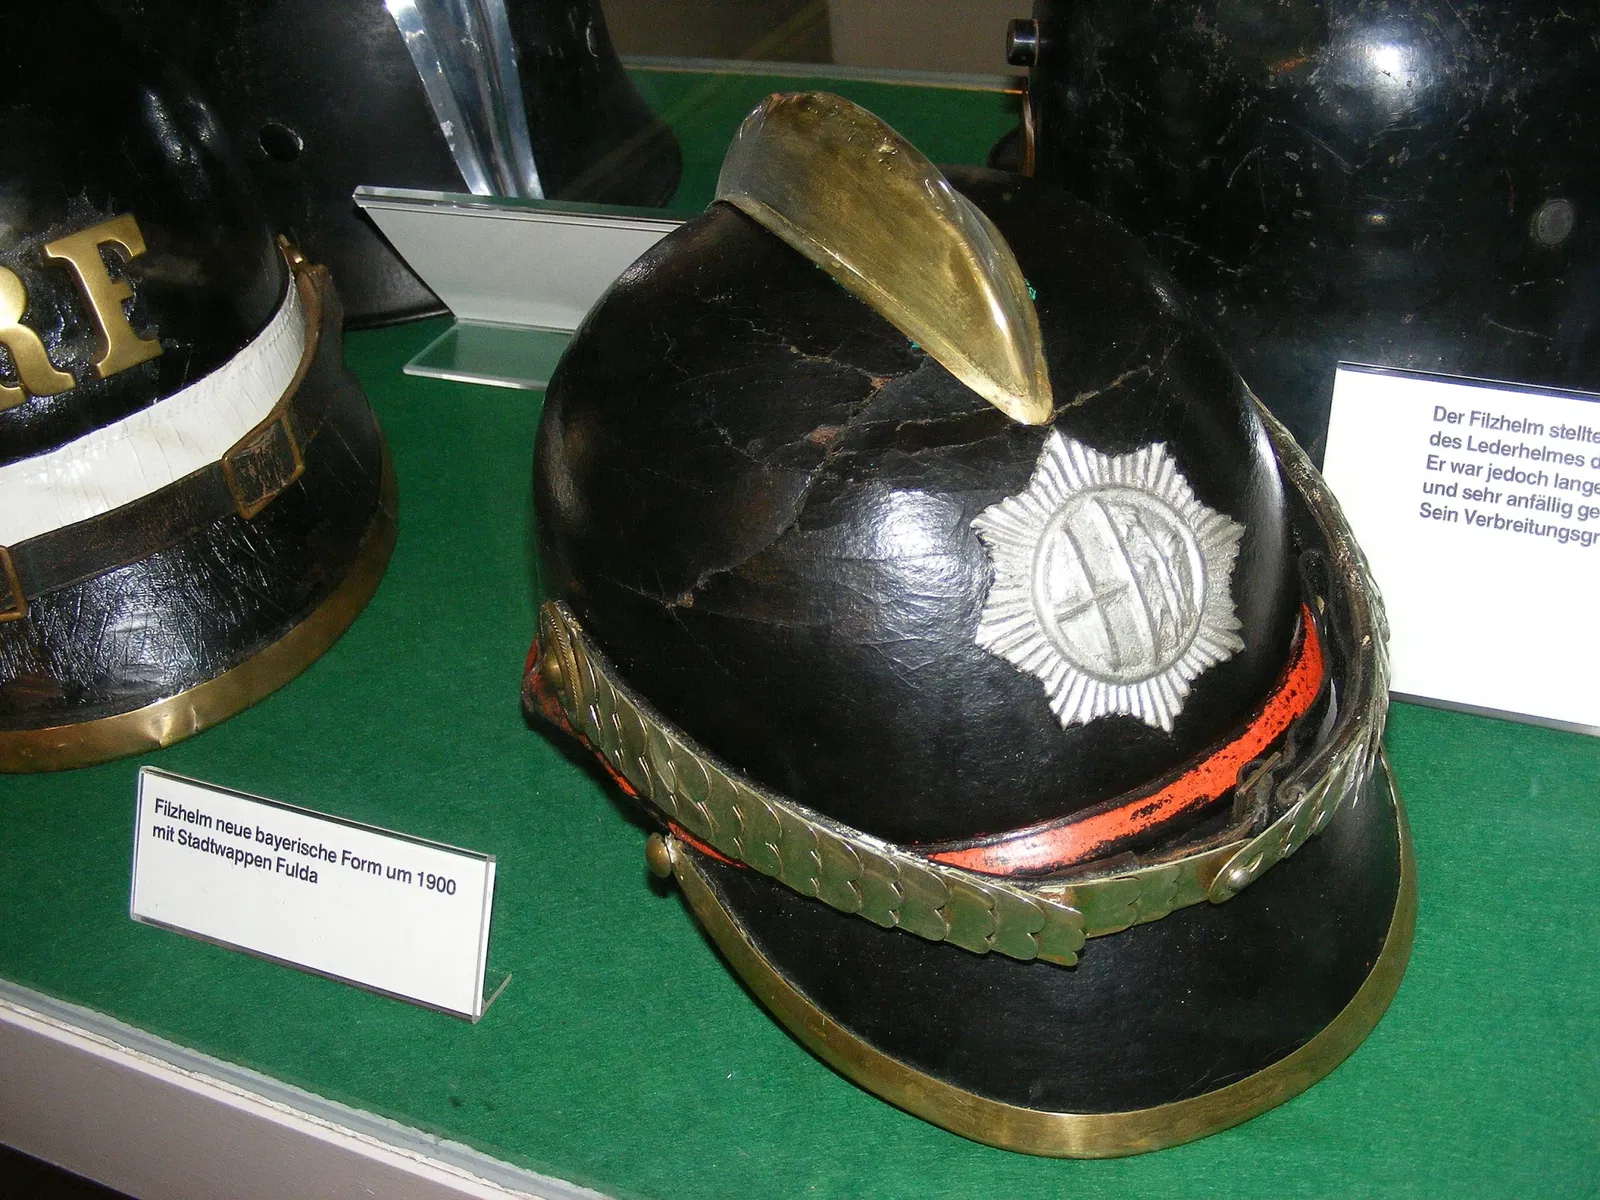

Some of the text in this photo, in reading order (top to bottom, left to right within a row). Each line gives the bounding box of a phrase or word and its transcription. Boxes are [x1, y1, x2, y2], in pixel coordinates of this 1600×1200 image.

[1433, 405, 1600, 444] Der Filzhelm stellte
[1429, 431, 1462, 449] des
[1467, 435, 1585, 467] Lederhelmes
[1426, 454, 1446, 472] Er
[1451, 461, 1483, 477] war
[1486, 463, 1548, 487] jedoch
[1419, 502, 1458, 523] Sein
[1423, 482, 1458, 497] und
[1462, 487, 1503, 504] sehr
[1506, 494, 1573, 519] anfällig
[152, 825, 318, 884] mit Stadtwappen Fulda
[154, 798, 456, 895] Filzhelm neue bayerische Form um 1900
